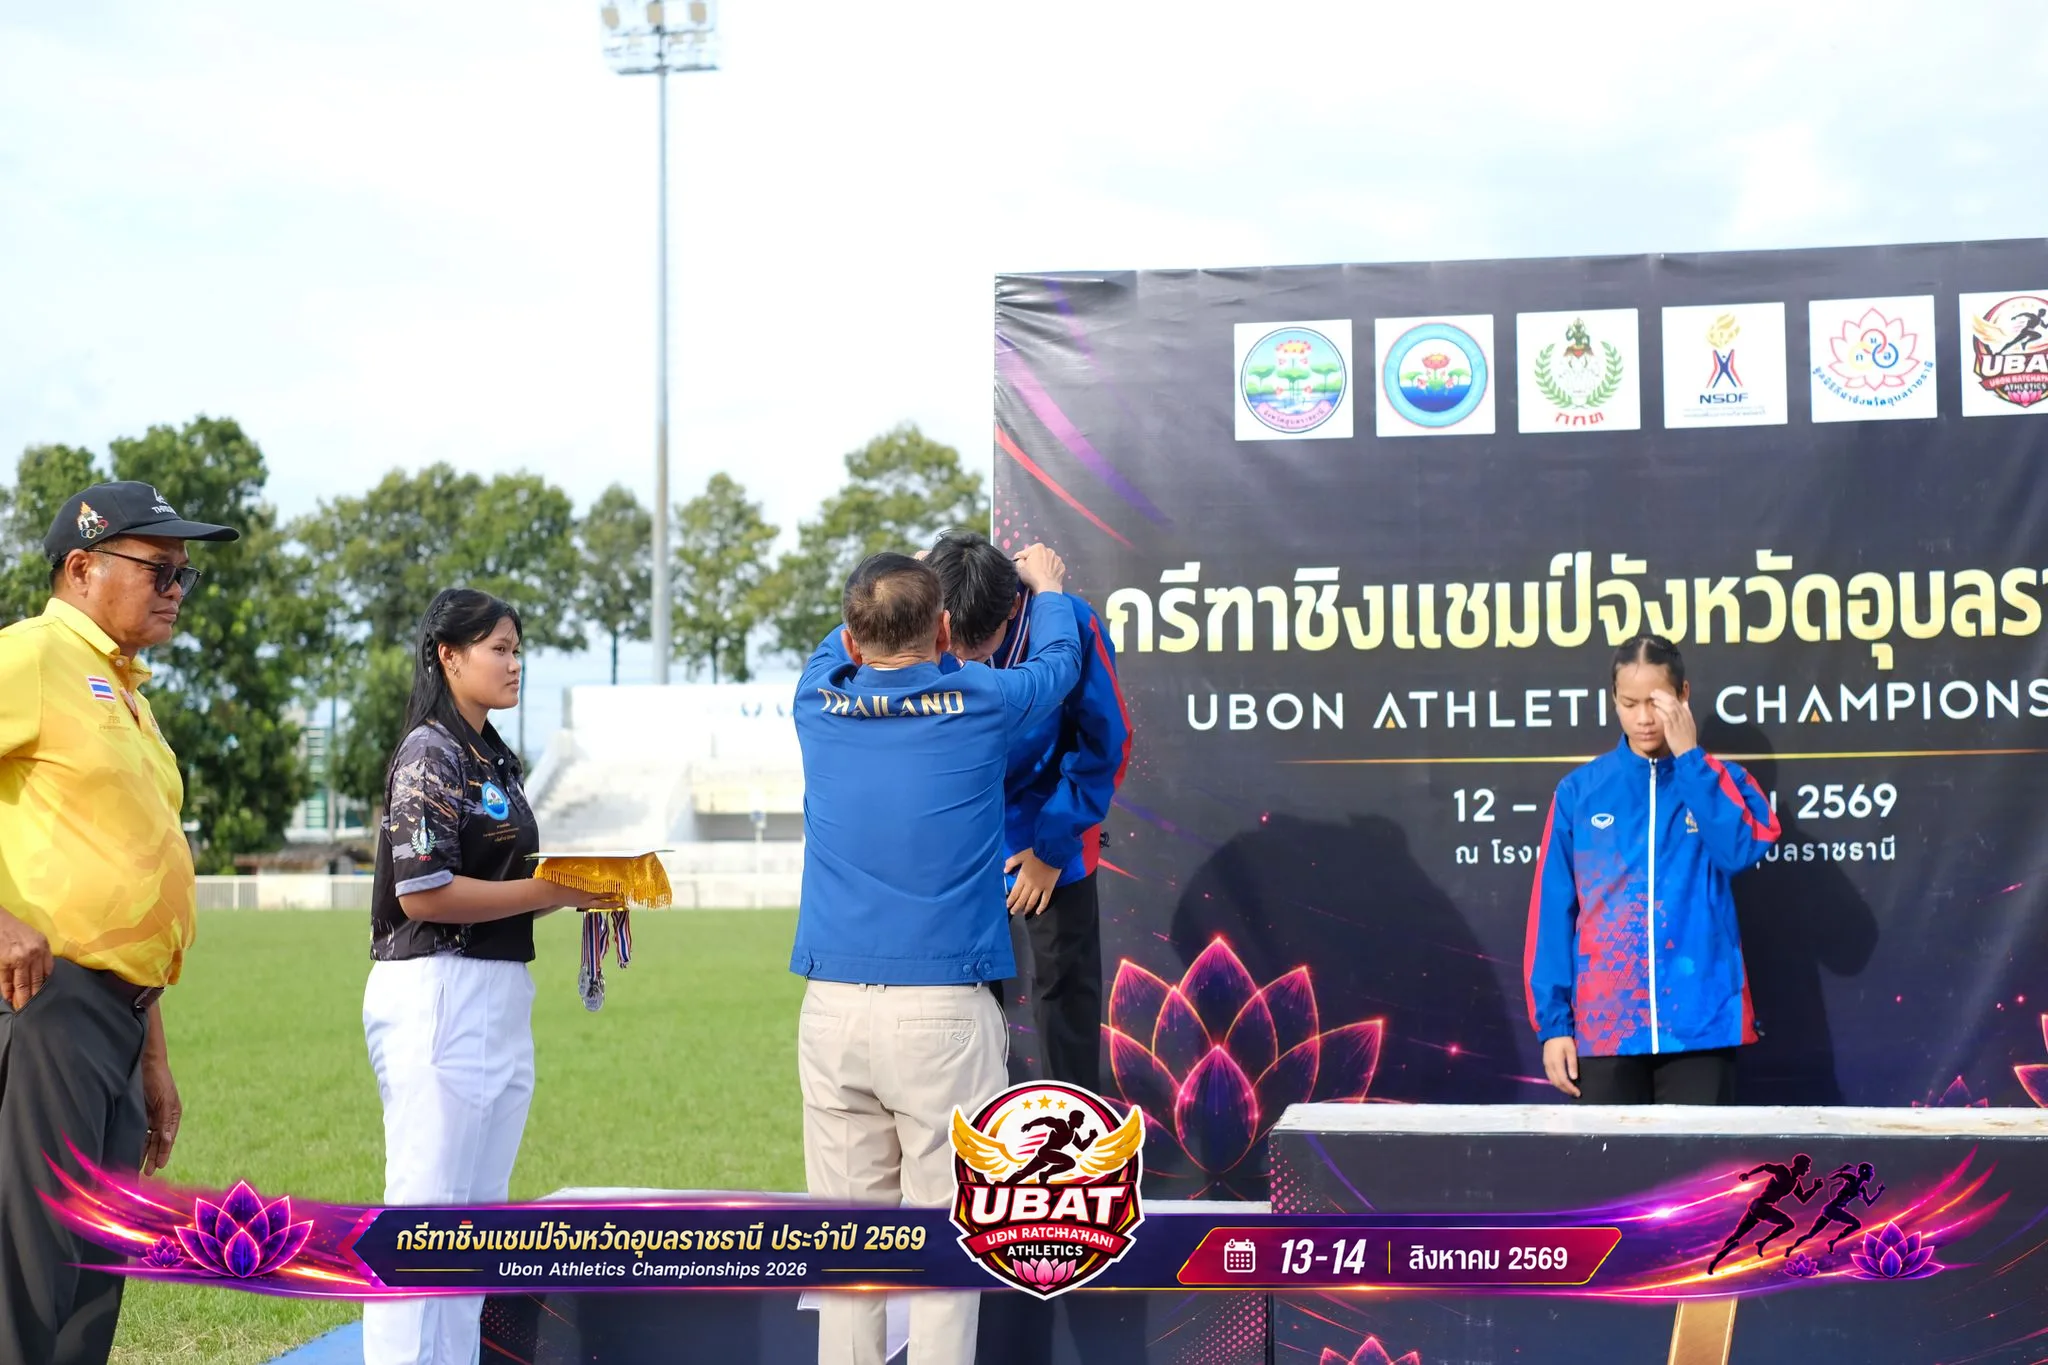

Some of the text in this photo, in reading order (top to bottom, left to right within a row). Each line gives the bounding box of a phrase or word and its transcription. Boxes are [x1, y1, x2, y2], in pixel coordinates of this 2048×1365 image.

[1981, 354, 2048, 377] UBA
[1699, 393, 1748, 404] NSDF
[1106, 549, 2048, 671] กรีฑาชิงแชมป์จังหวัดอุบลร
[817, 687, 965, 717] THAILAND
[1187, 692, 1343, 731] UBON
[1373, 689, 1607, 730] ATHLETI
[1453, 788, 1495, 822] 12
[1797, 783, 1897, 819] 2569
[1455, 845, 1478, 864] ณ
